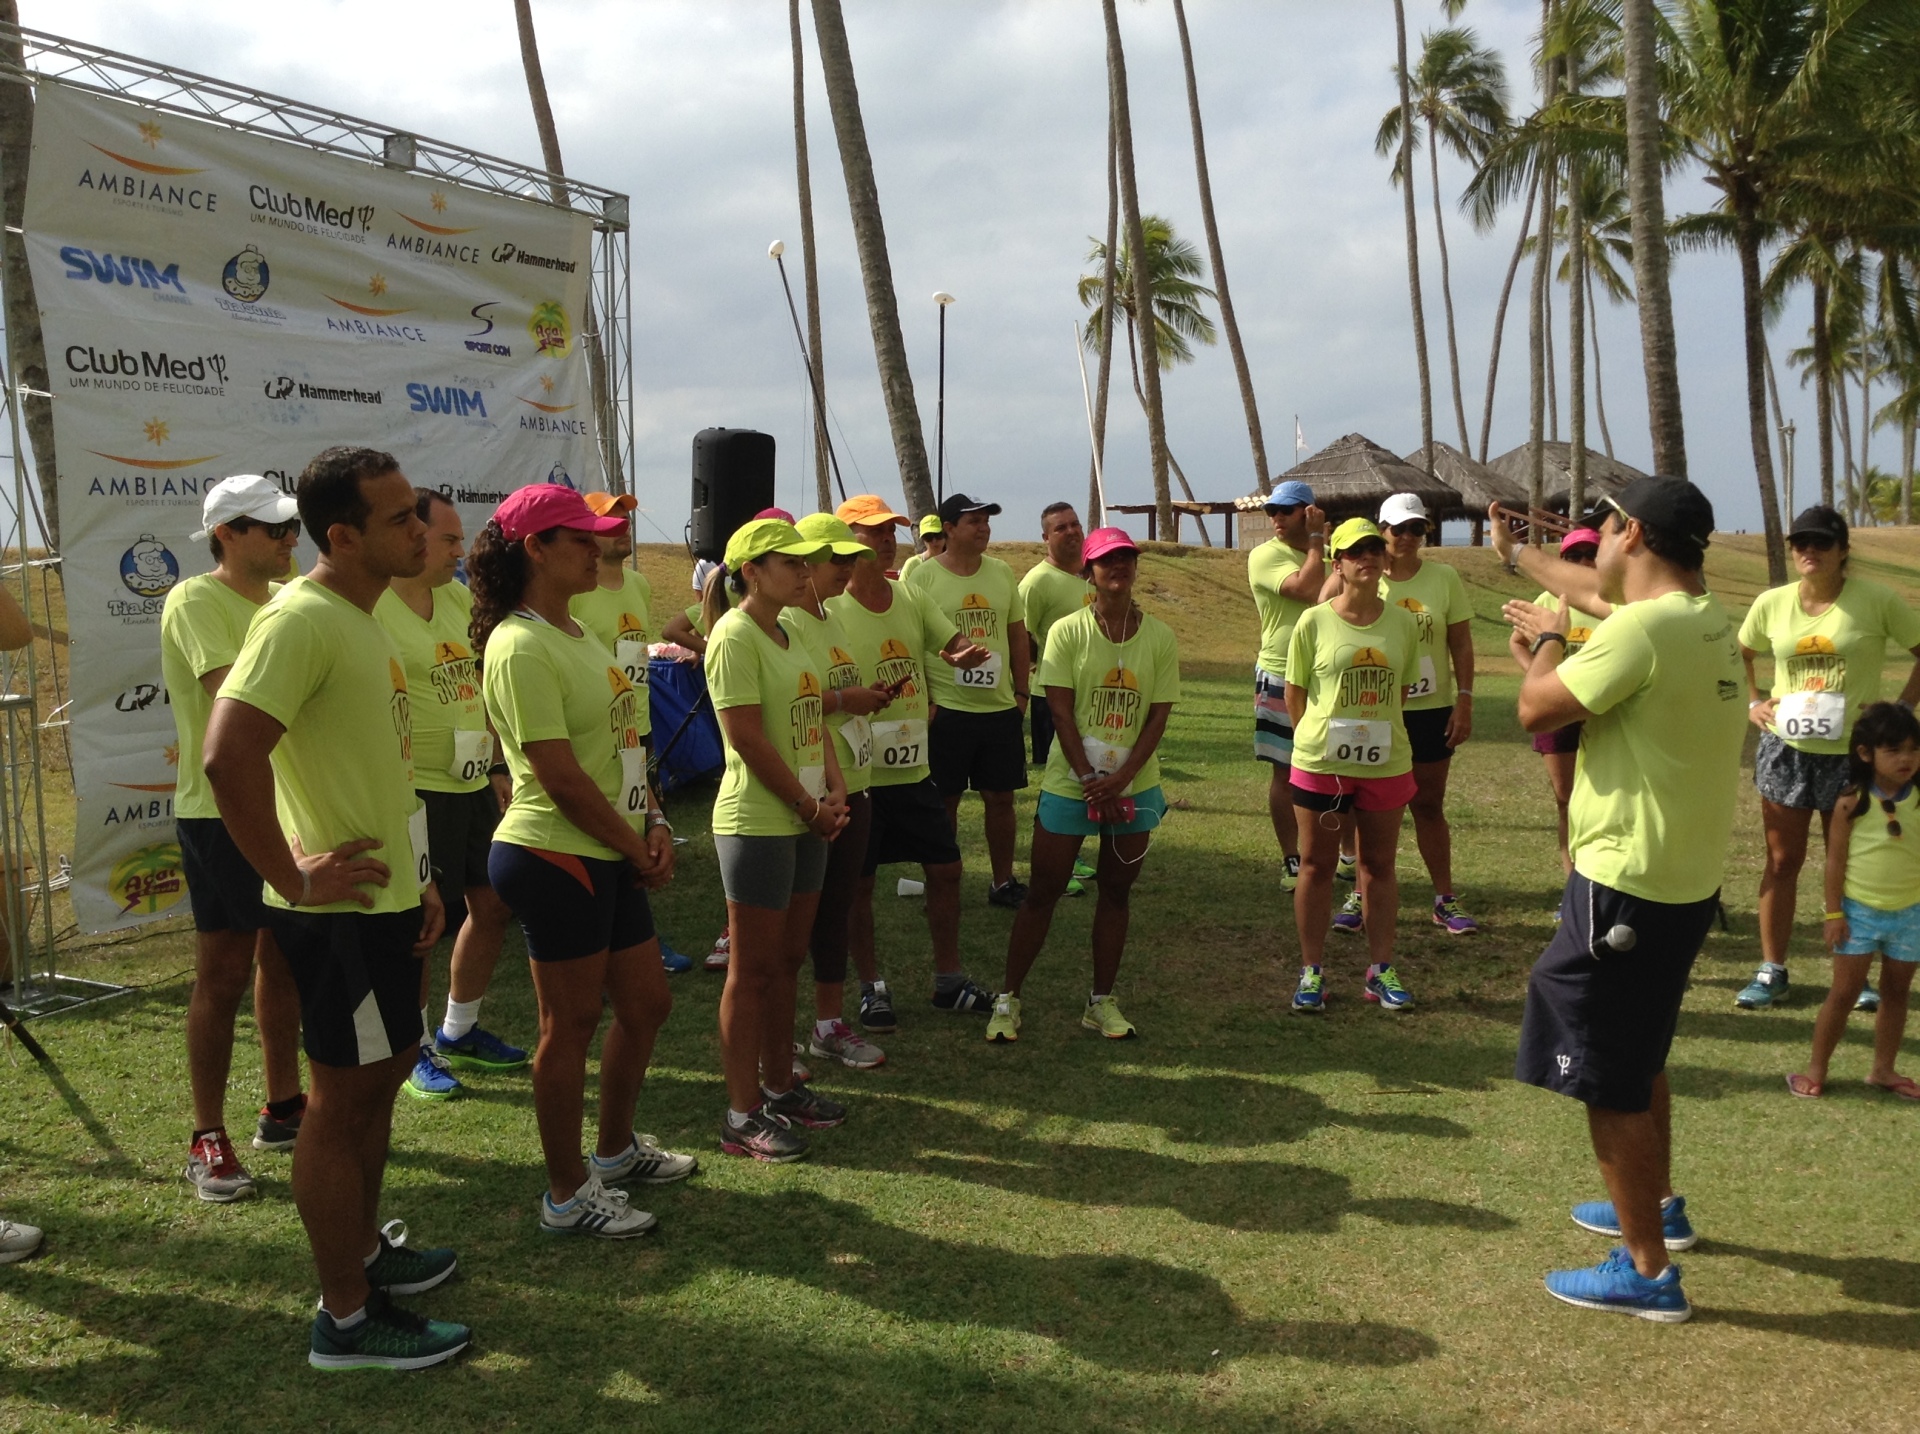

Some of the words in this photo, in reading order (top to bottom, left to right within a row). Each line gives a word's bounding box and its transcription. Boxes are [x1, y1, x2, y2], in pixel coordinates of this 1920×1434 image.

[78, 169, 217, 212] AMBIANCE
[249, 184, 303, 218] Club
[304, 197, 355, 229] Med
[250, 213, 266, 223] UM
[268, 216, 305, 232] MUNDO
[307, 224, 319, 235] DE
[321, 227, 367, 245] FELICIDADE
[386, 232, 480, 264] AMBIANCE
[60, 246, 187, 294] SWIM
[516, 249, 576, 274] Hammerhead
[326, 316, 427, 342] AMBIANCE
[65, 345, 139, 376] Club
[142, 351, 206, 381] Med
[69, 377, 90, 388] UM
[93, 379, 141, 391] MUNDO
[144, 382, 160, 392] DE
[162, 383, 226, 397] FELICIDADE
[298, 383, 382, 404] Hammerhead
[405, 382, 488, 418] SWIM
[519, 415, 587, 435] AMBIANCE
[88, 476, 217, 496] AMBIANC
[262, 469, 298, 495] Clu
[126, 499, 159, 507] ESPORTE
[168, 499, 201, 507] TURISMO
[456, 489, 511, 504] Hammerh
[954, 610, 999, 640] SUMMER
[962, 669, 995, 685] 025
[1341, 668, 1395, 708] SUMMER
[1408, 677, 1430, 695] 32
[1088, 689, 1143, 733] SUMMER
[1359, 690, 1379, 708] RUN
[790, 699, 823, 750] SUMME
[1103, 712, 1124, 731] RUN
[1360, 710, 1379, 718] 2015
[1103, 732, 1124, 742] 2015
[1786, 718, 1832, 737] 035
[883, 744, 920, 765] 027
[1336, 743, 1381, 763] 016
[627, 785, 647, 812] 02
[103, 798, 172, 826] AMBI
